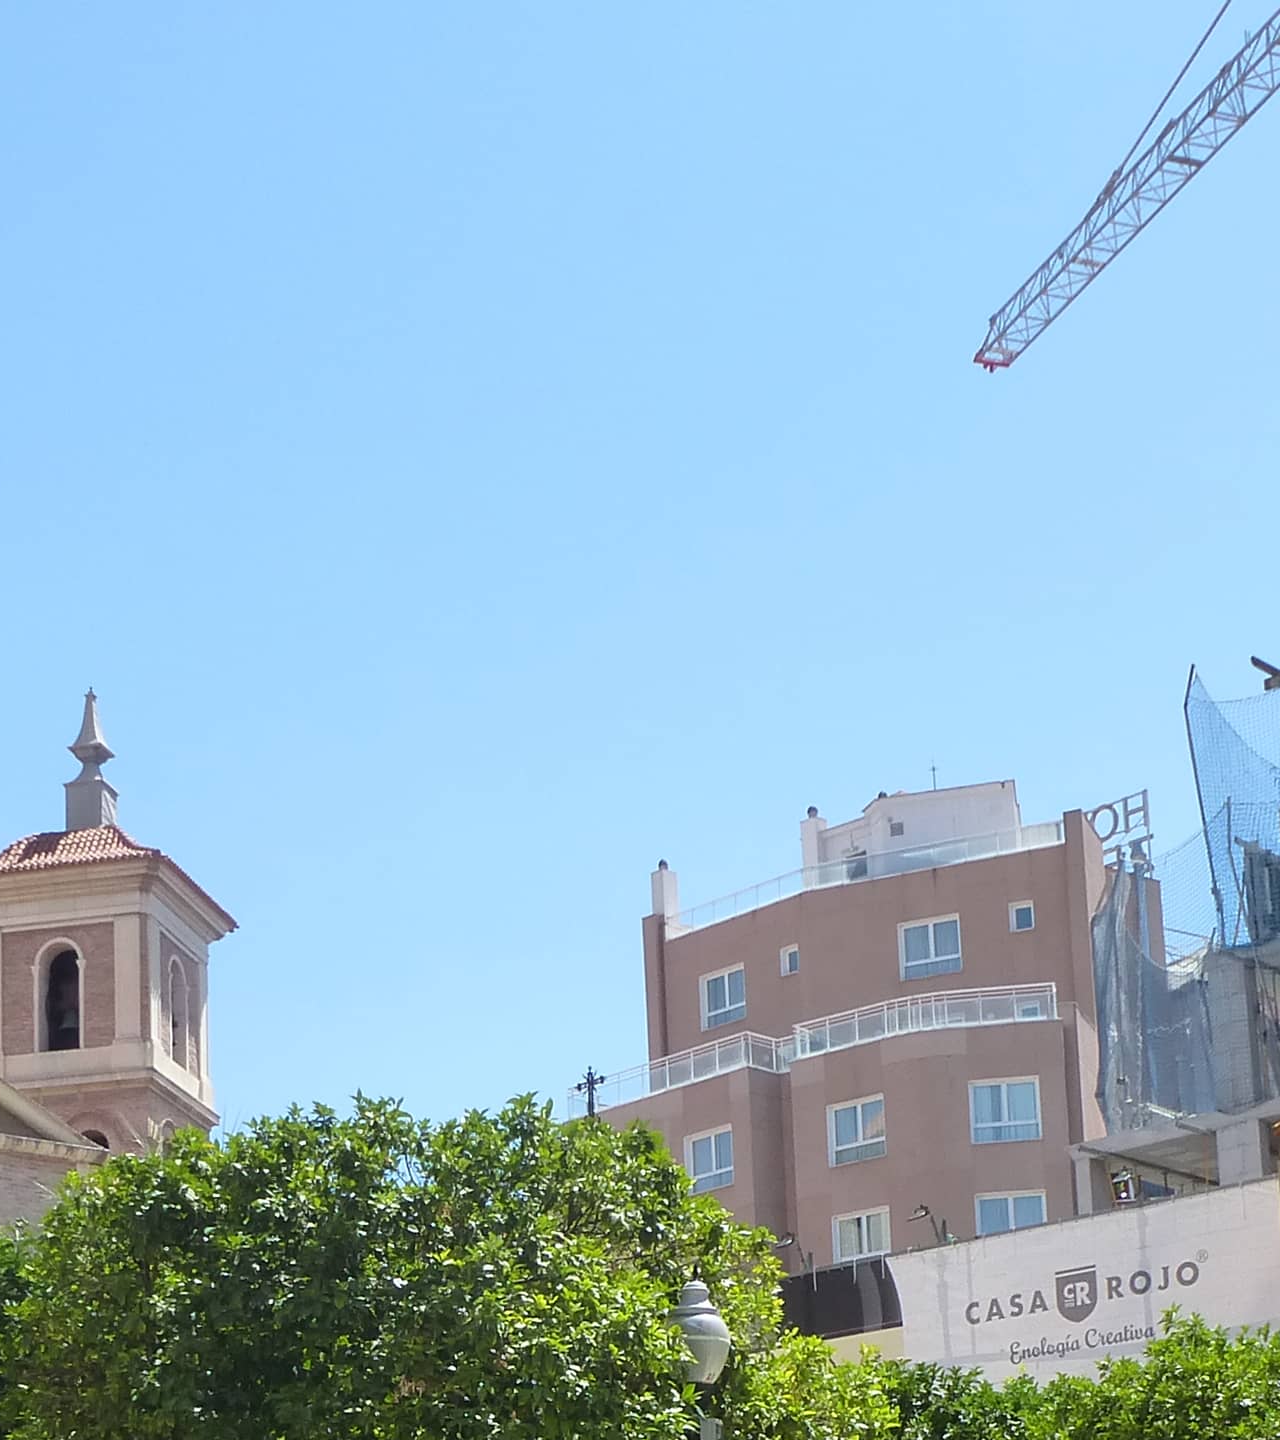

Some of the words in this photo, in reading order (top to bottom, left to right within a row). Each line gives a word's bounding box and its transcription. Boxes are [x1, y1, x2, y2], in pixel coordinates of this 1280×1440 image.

[965, 1290, 1049, 1325] CASA
[1010, 1335, 1080, 1365] Enología
[1085, 1324, 1155, 1349] Creativa
